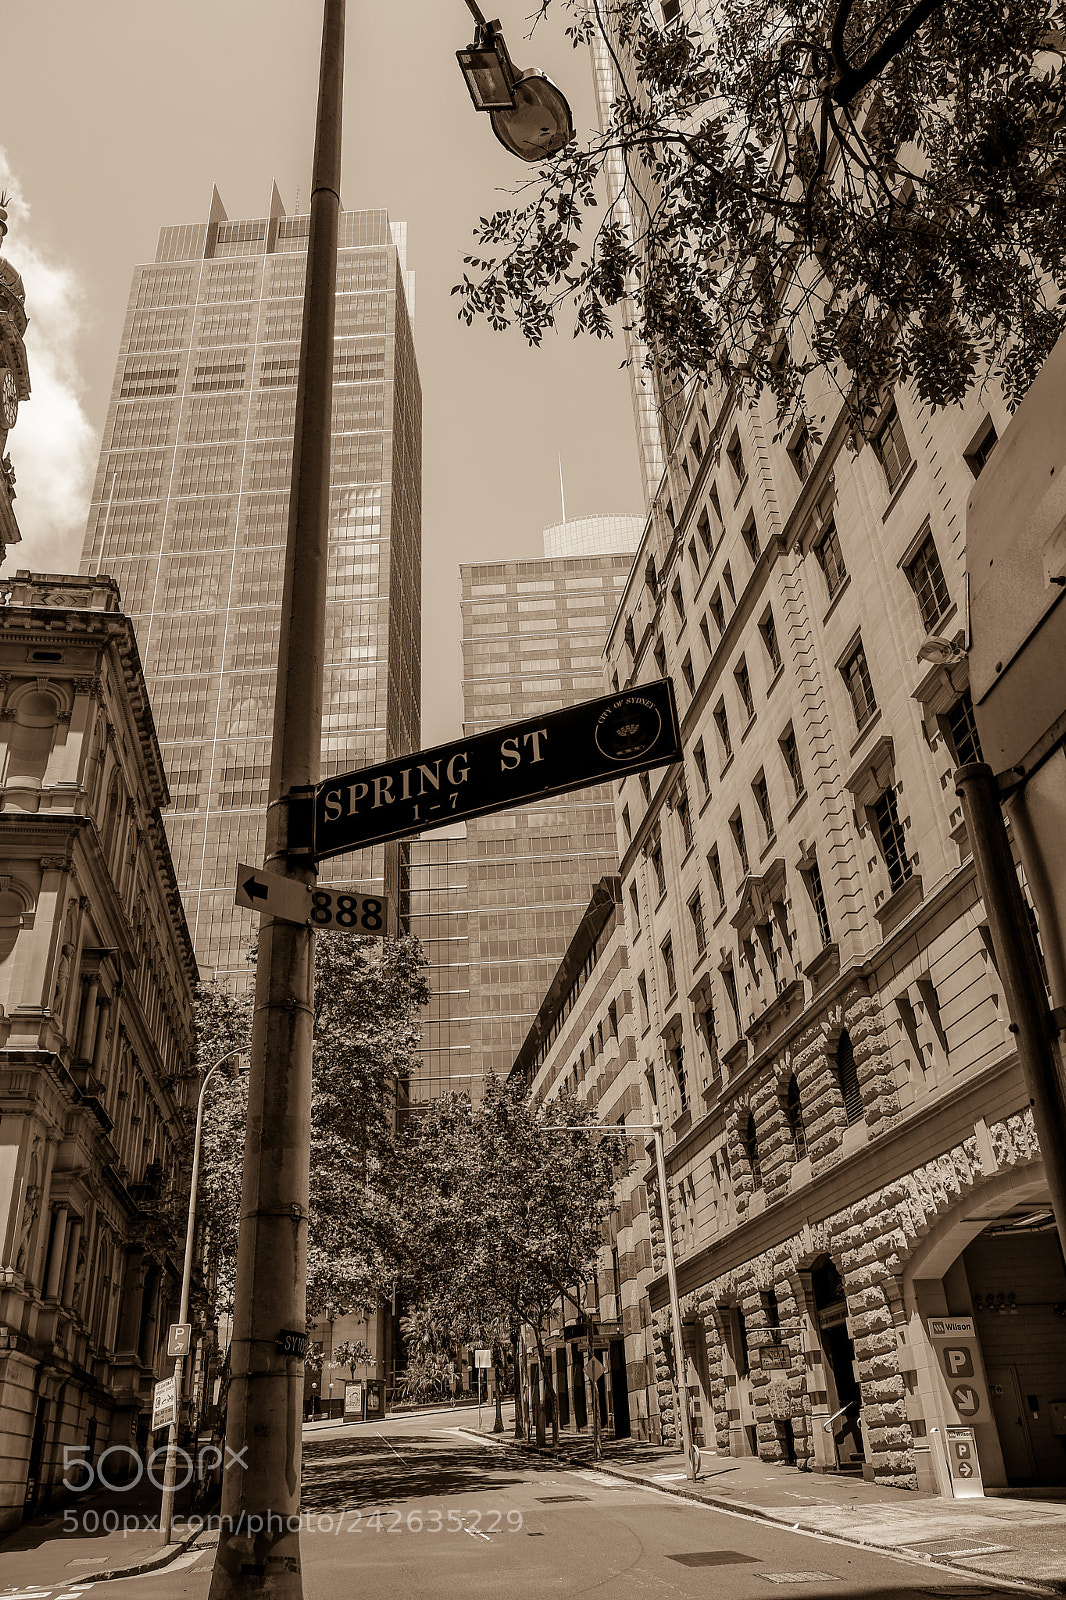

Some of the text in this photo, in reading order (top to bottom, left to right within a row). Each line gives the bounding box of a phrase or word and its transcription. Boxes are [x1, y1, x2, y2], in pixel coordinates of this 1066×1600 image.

[597, 697, 657, 724] CITY OF SYDNEY
[323, 728, 549, 823] SPRING ST
[310, 890, 384, 930] 888
[174, 1327, 185, 1340] P
[945, 1322, 972, 1332] Wilson
[948, 1350, 967, 1374] P
[958, 1444, 967, 1457] P
